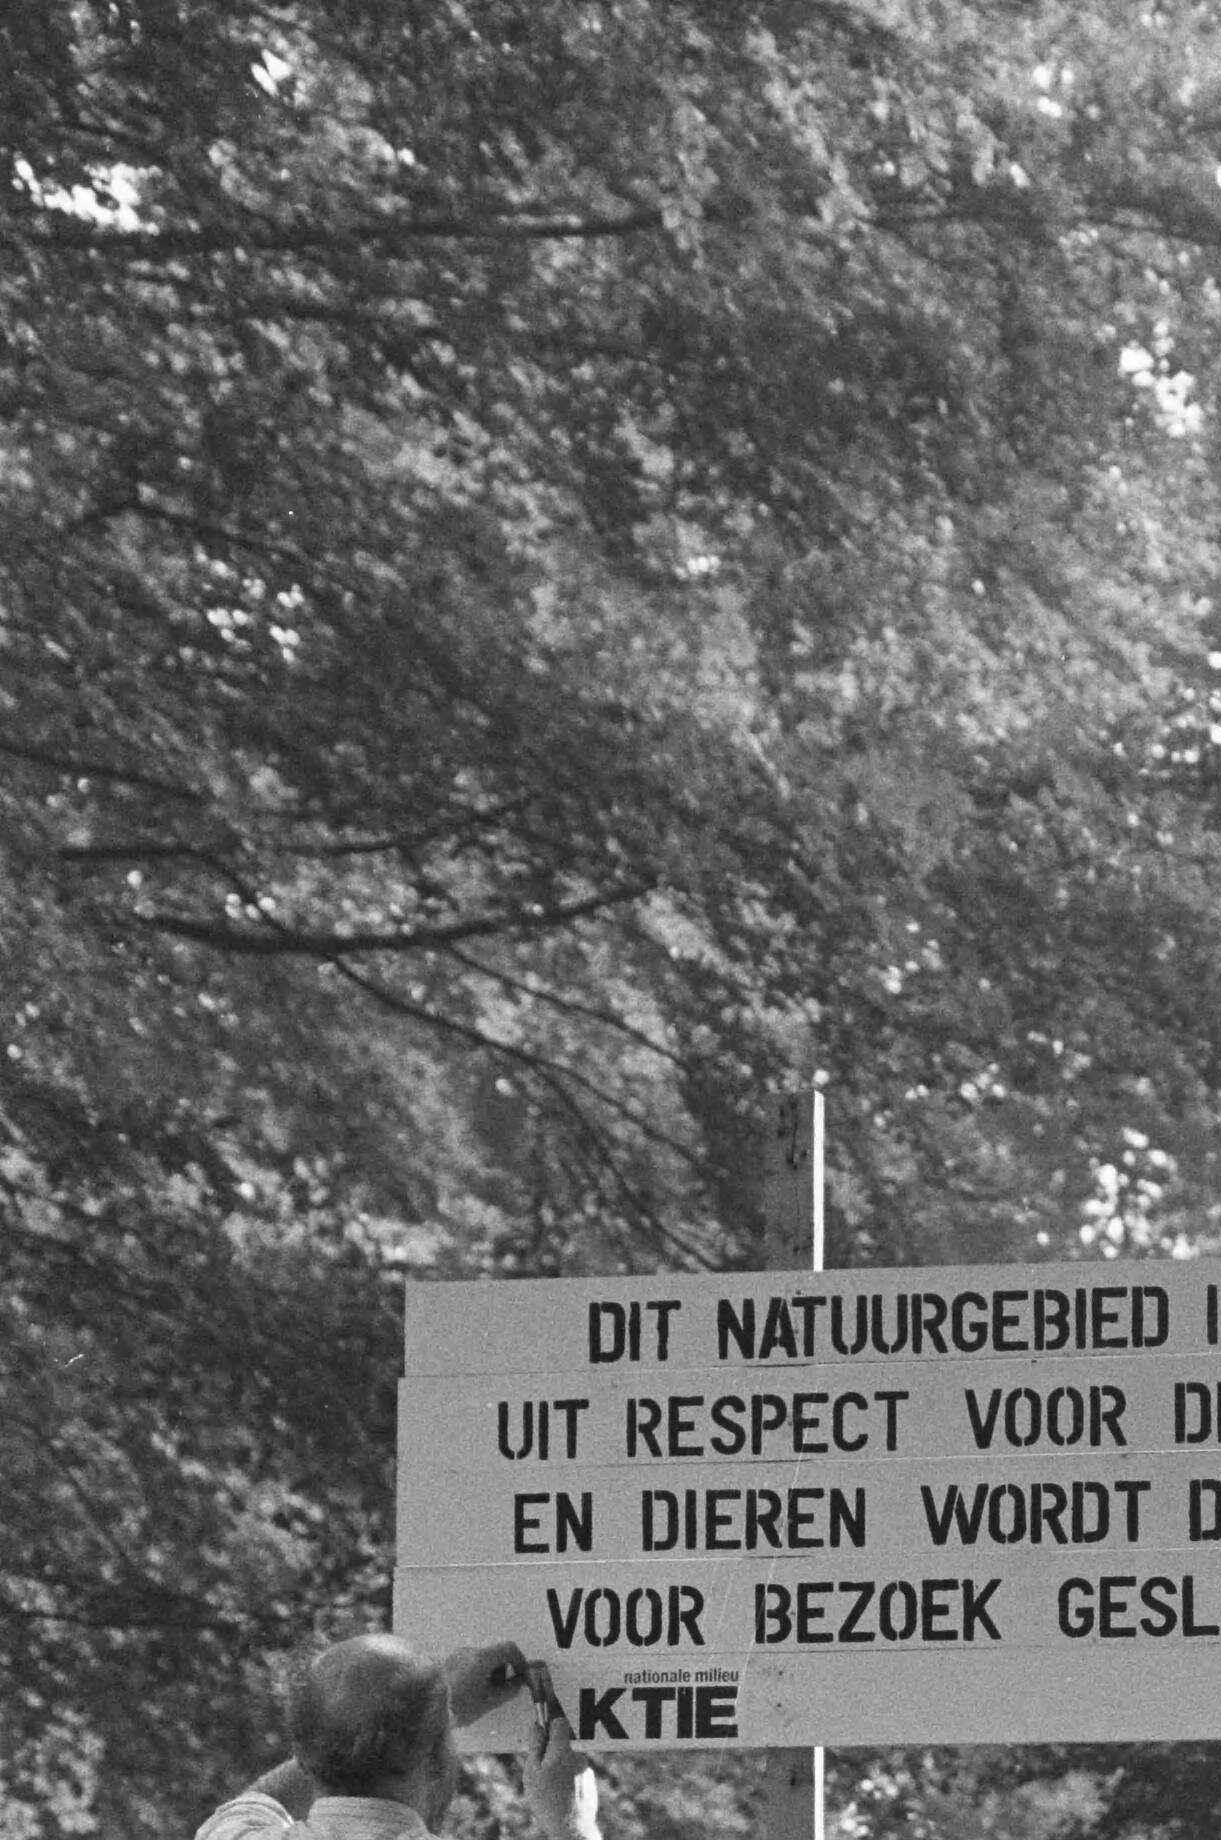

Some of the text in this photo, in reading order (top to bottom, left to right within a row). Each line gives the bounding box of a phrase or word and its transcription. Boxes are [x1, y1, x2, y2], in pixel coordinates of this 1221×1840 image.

[589, 1301, 681, 1363] DIT
[718, 1287, 1168, 1359] NATUURGEBIED
[499, 1399, 589, 1460] UIT
[627, 1391, 909, 1457] RESPECT
[965, 1386, 1126, 1449] VOOR
[515, 1493, 592, 1553] EN
[643, 1488, 865, 1551] DIEREN
[921, 1481, 1150, 1545] WORDT
[547, 1586, 704, 1648] VOOR
[756, 1579, 1001, 1643] BEZOEK
[623, 1667, 739, 1684] nationale milieu
